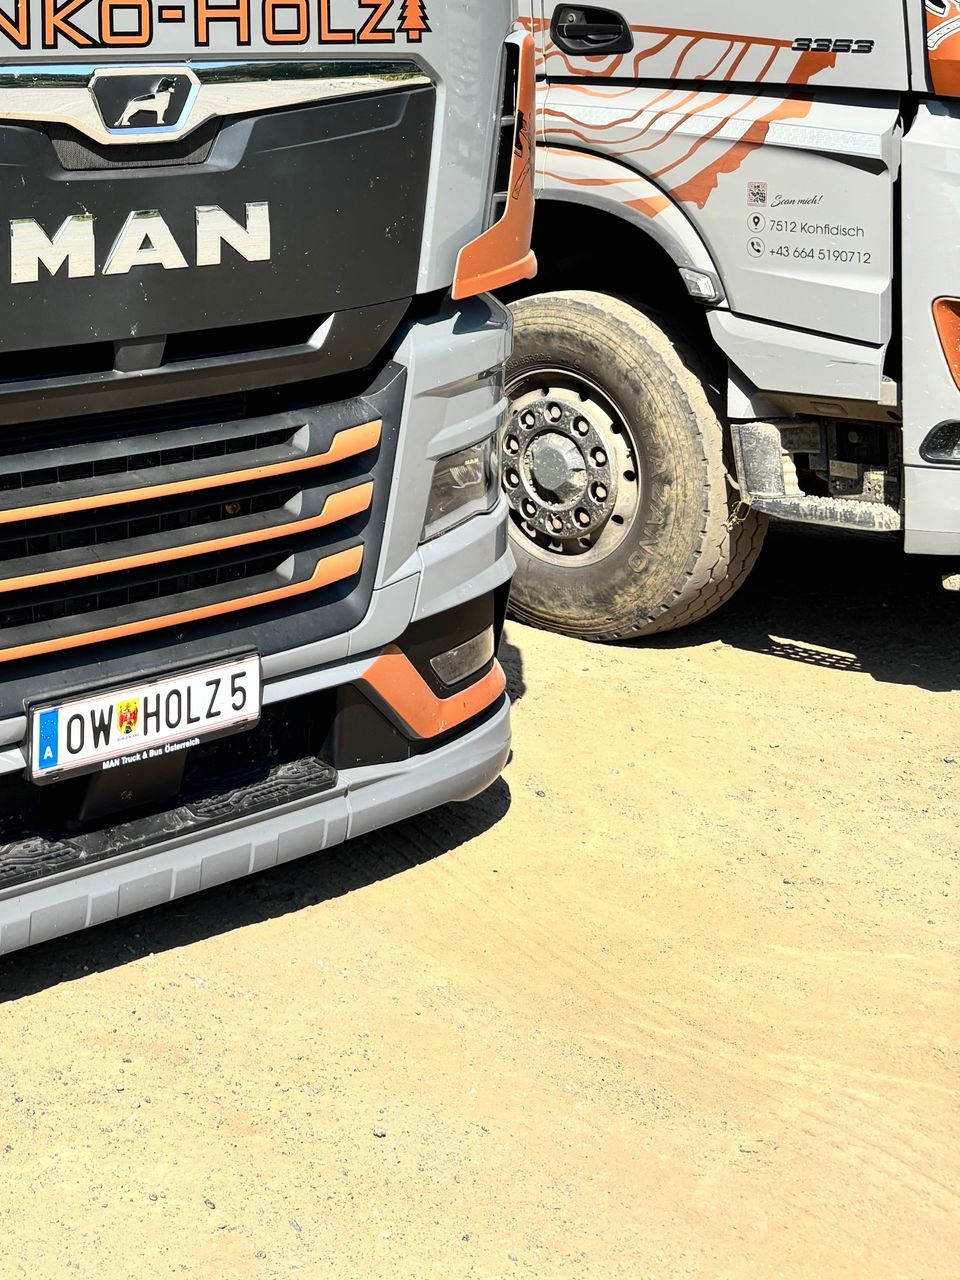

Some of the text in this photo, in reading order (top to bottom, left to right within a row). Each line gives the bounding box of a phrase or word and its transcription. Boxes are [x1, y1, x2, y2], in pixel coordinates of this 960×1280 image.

[791, 37, 876, 55] 3353
[770, 194, 823, 208] Scan mich!
[770, 220, 865, 237] 7512 Kohfidisch
[9, 201, 272, 285] MAN
[769, 246, 872, 264] +43 664 5190712
[43, 745, 53, 760] A
[66, 704, 114, 755] OW
[102, 757, 120, 770] MAN
[121, 753, 142, 764] Truck
[149, 748, 163, 758] Bus
[164, 737, 200, 754] Österreich
